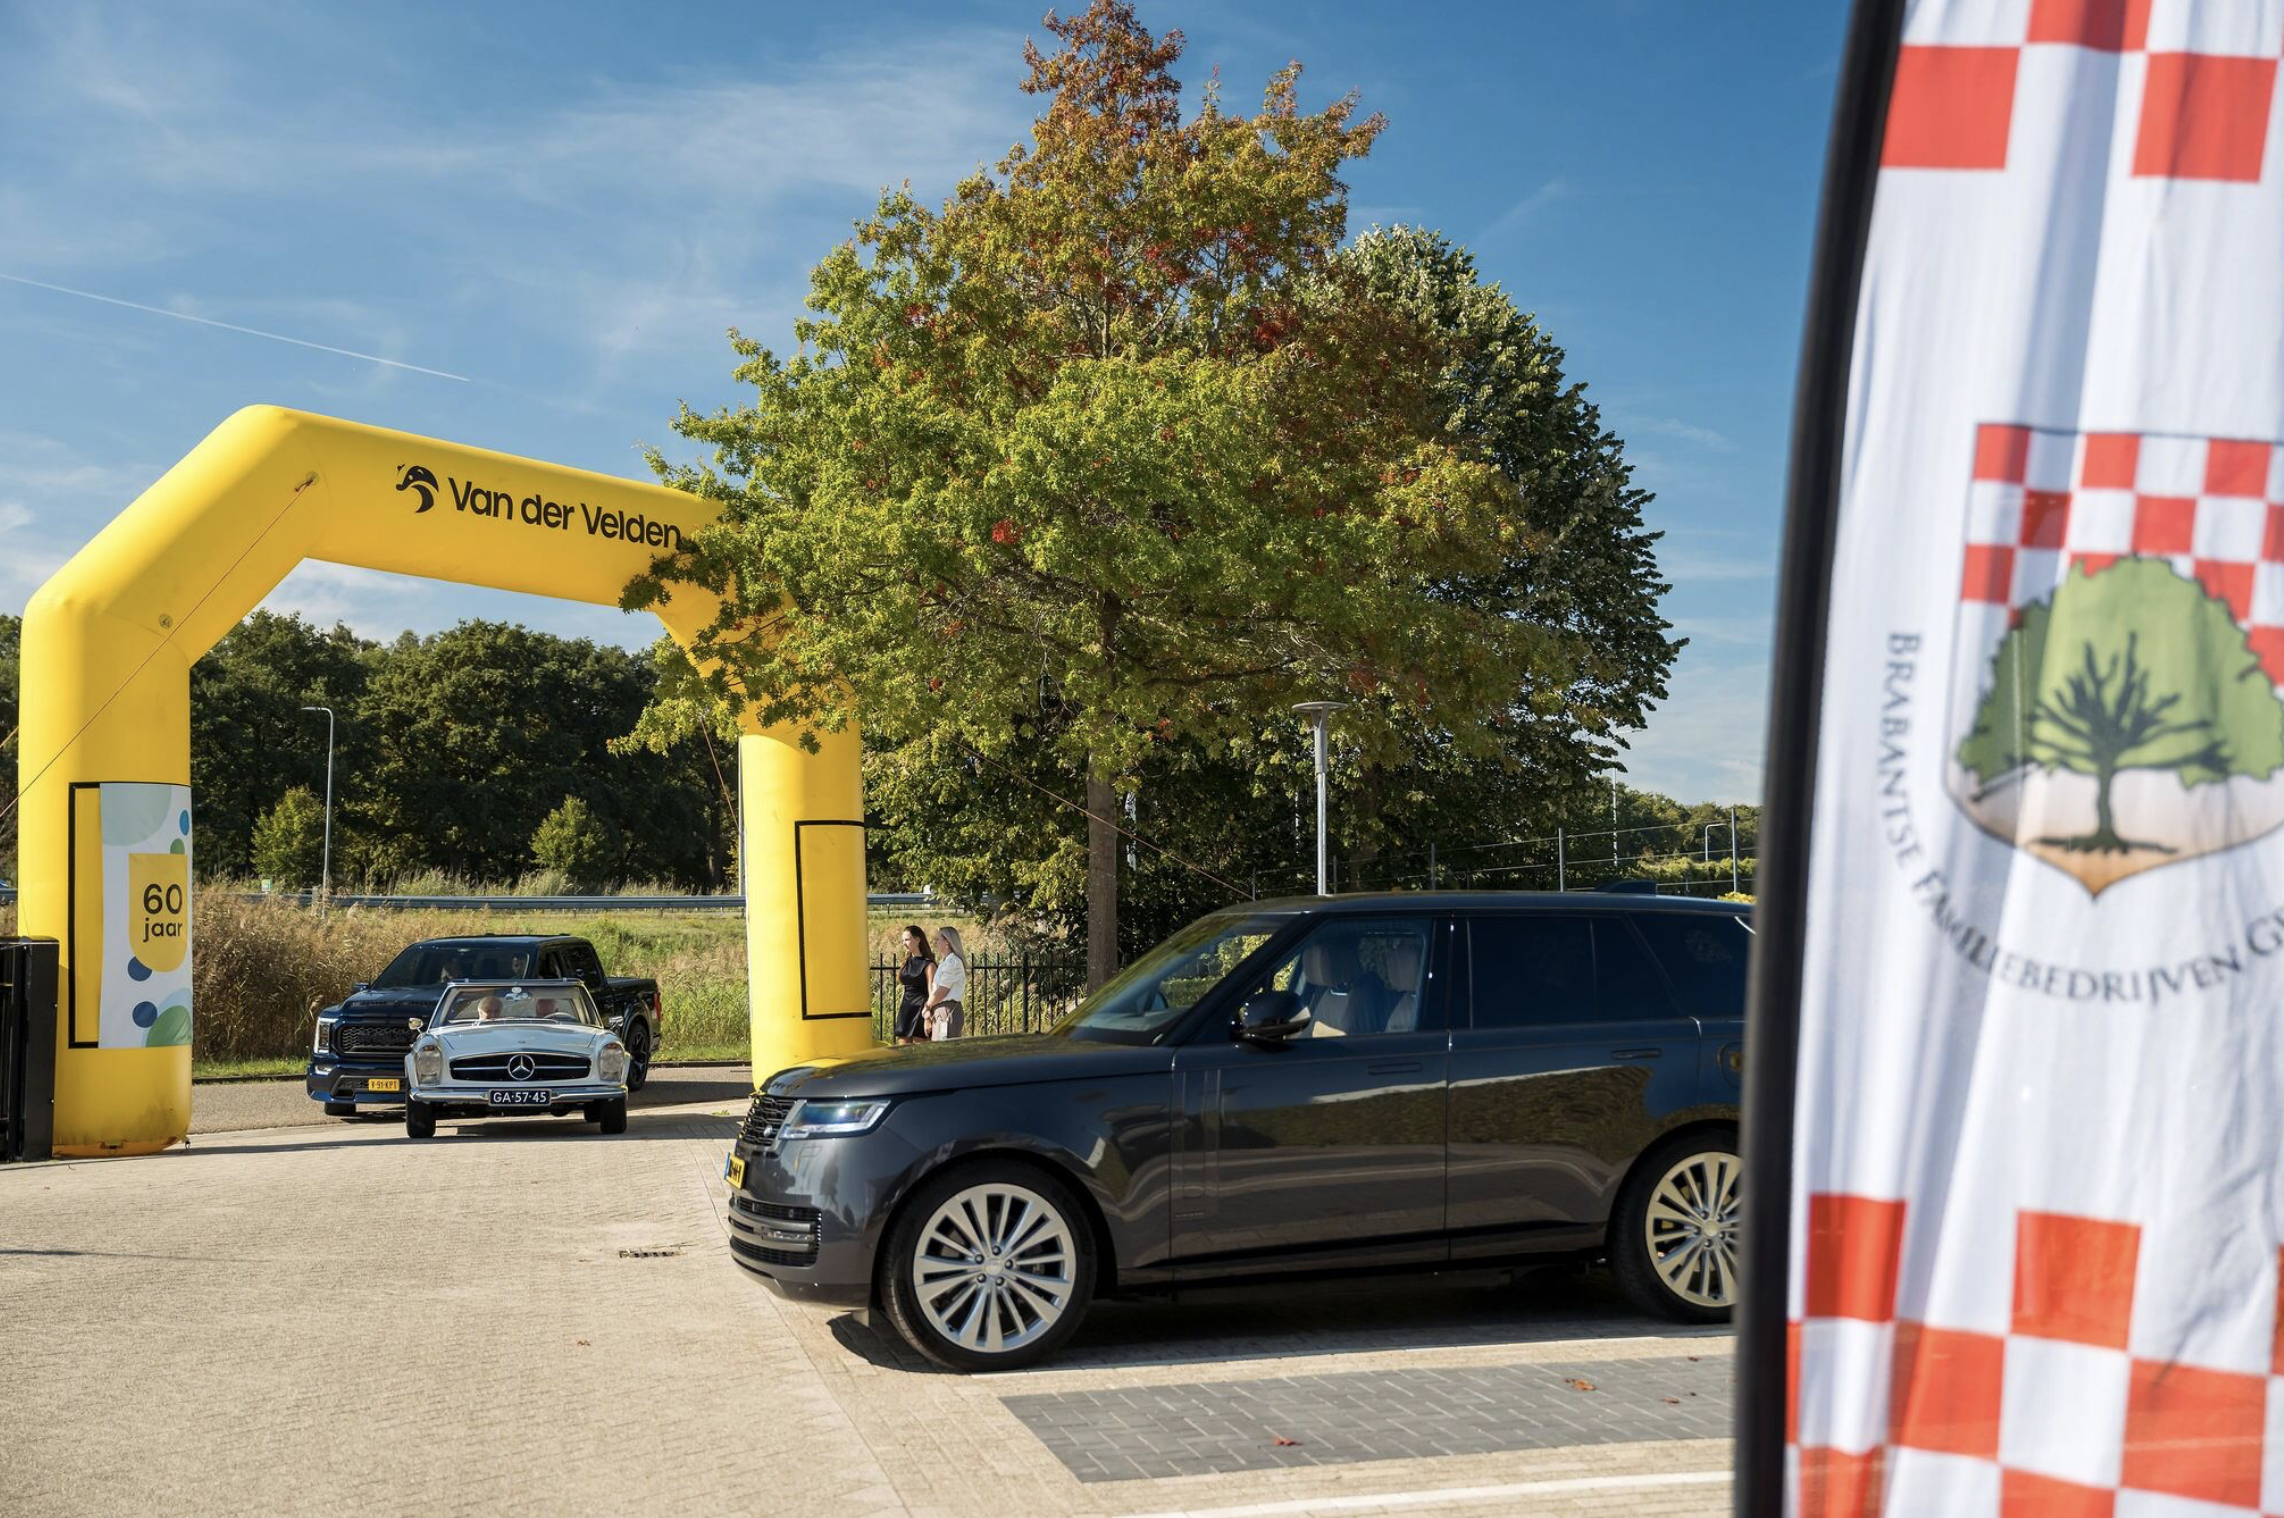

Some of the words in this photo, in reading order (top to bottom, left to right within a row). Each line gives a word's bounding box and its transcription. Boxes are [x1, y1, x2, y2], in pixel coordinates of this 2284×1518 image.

[447, 477, 514, 520] Van
[520, 494, 575, 530] der
[580, 502, 682, 550] Velden
[1877, 632, 1925, 870] BRABANTSE
[1912, 868, 2242, 1005] FAMILIEBEDRIJVEN
[143, 883, 183, 915] 60
[142, 917, 183, 942] jaar
